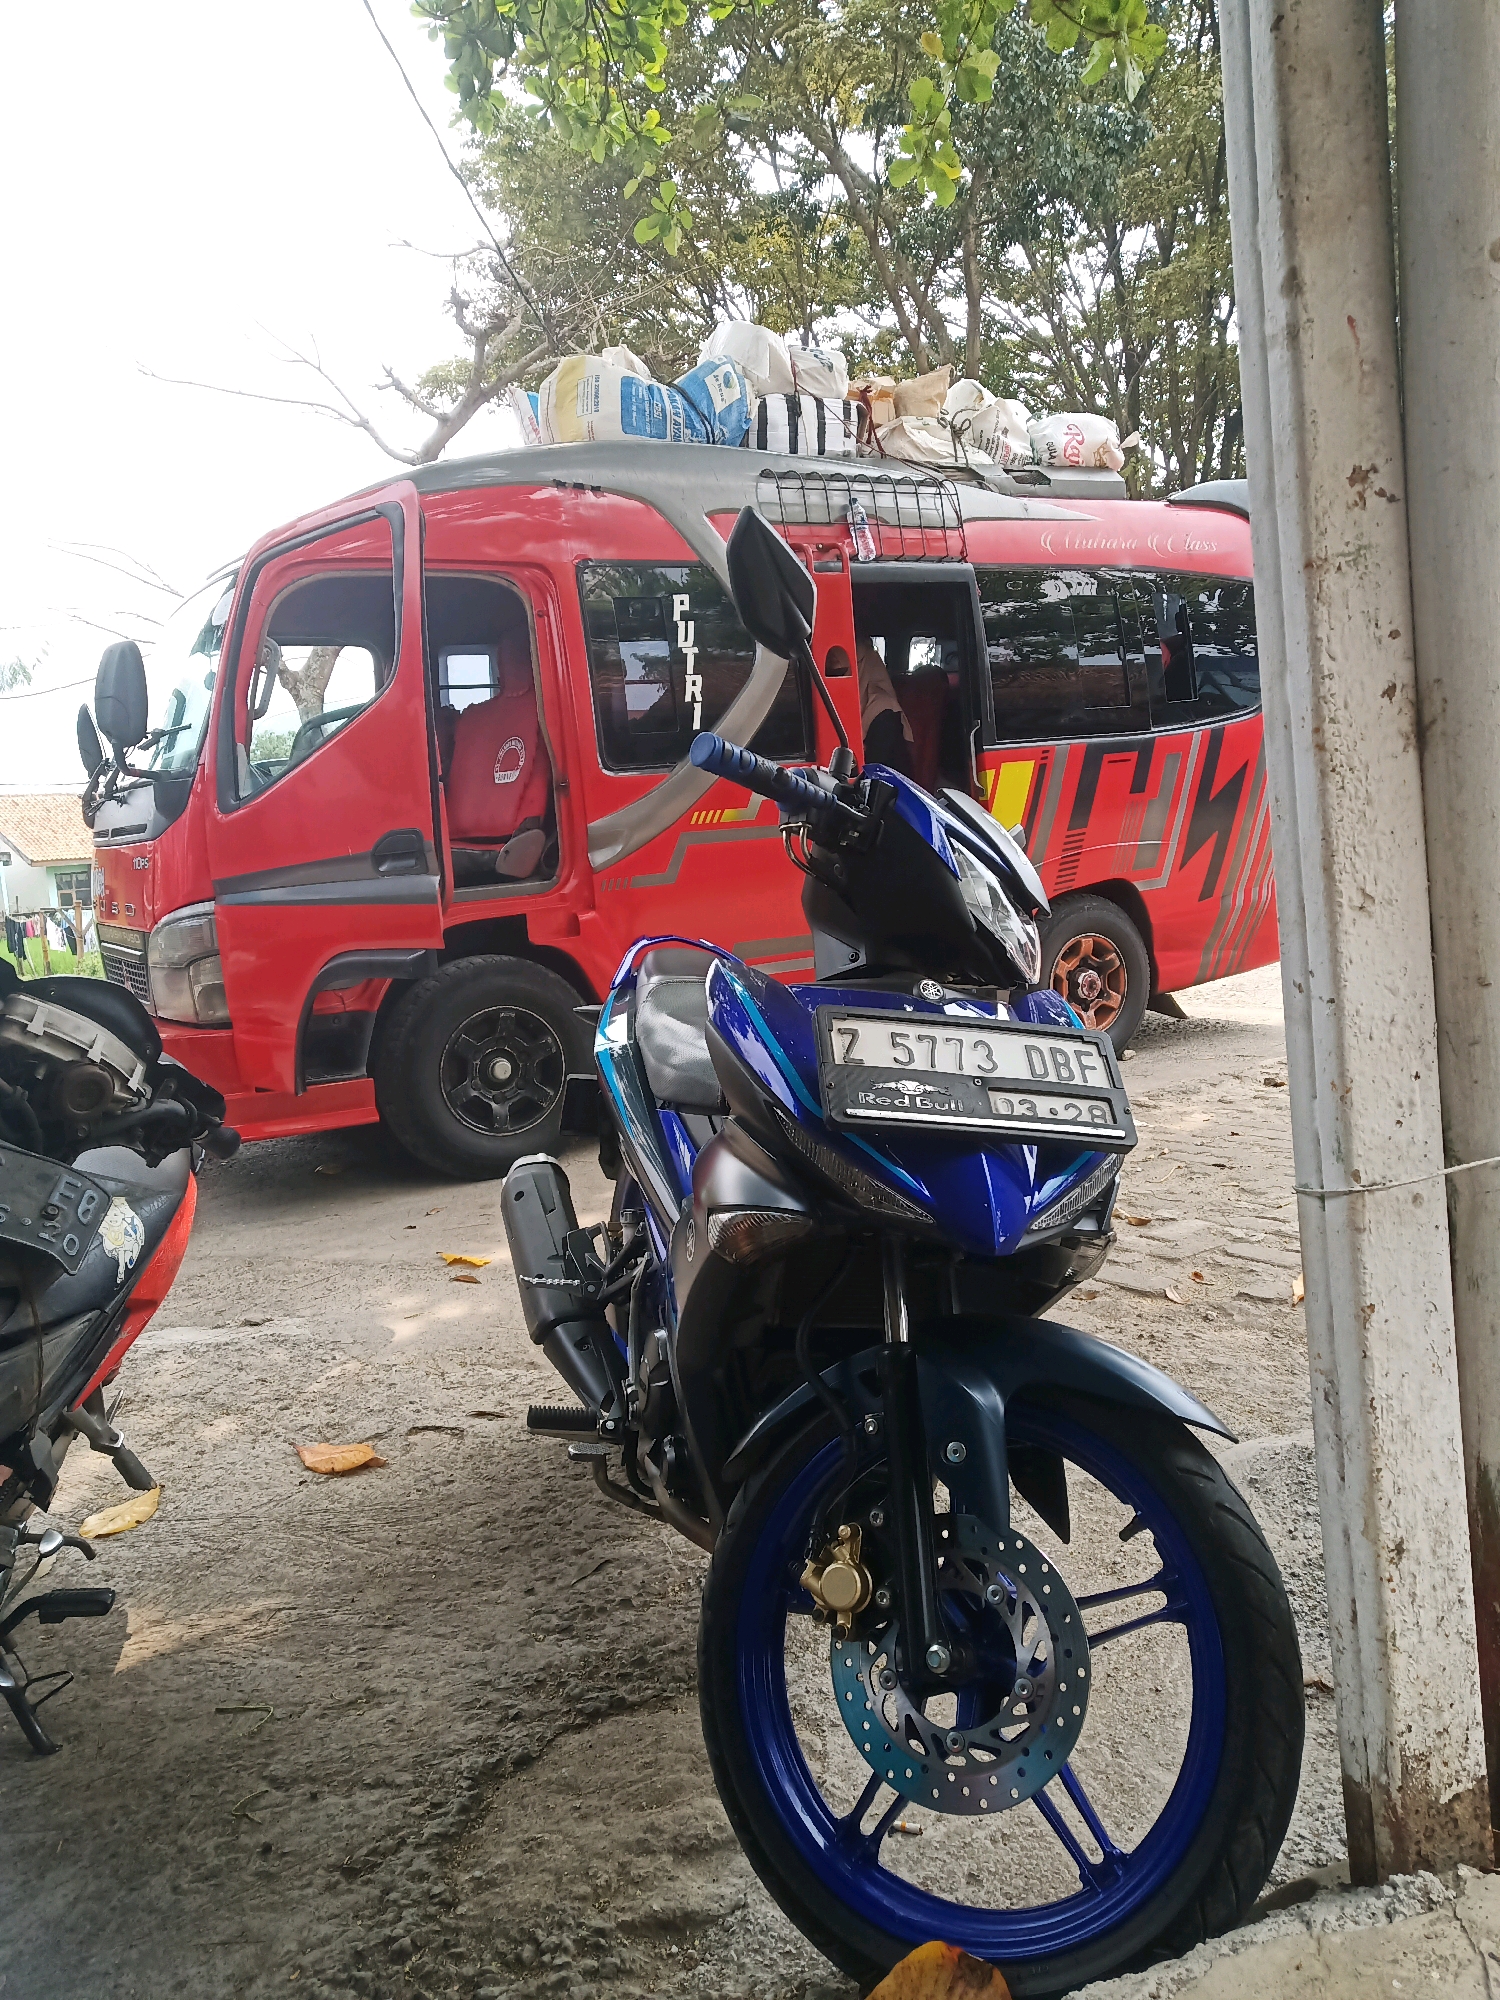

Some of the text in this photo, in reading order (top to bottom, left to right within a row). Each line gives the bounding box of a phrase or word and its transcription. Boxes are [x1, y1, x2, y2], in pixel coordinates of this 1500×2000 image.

[672, 593, 703, 731] PUTRI
[837, 1027, 865, 1065] Z
[889, 1031, 999, 1074] 5773
[1024, 1044, 1098, 1084] DBF
